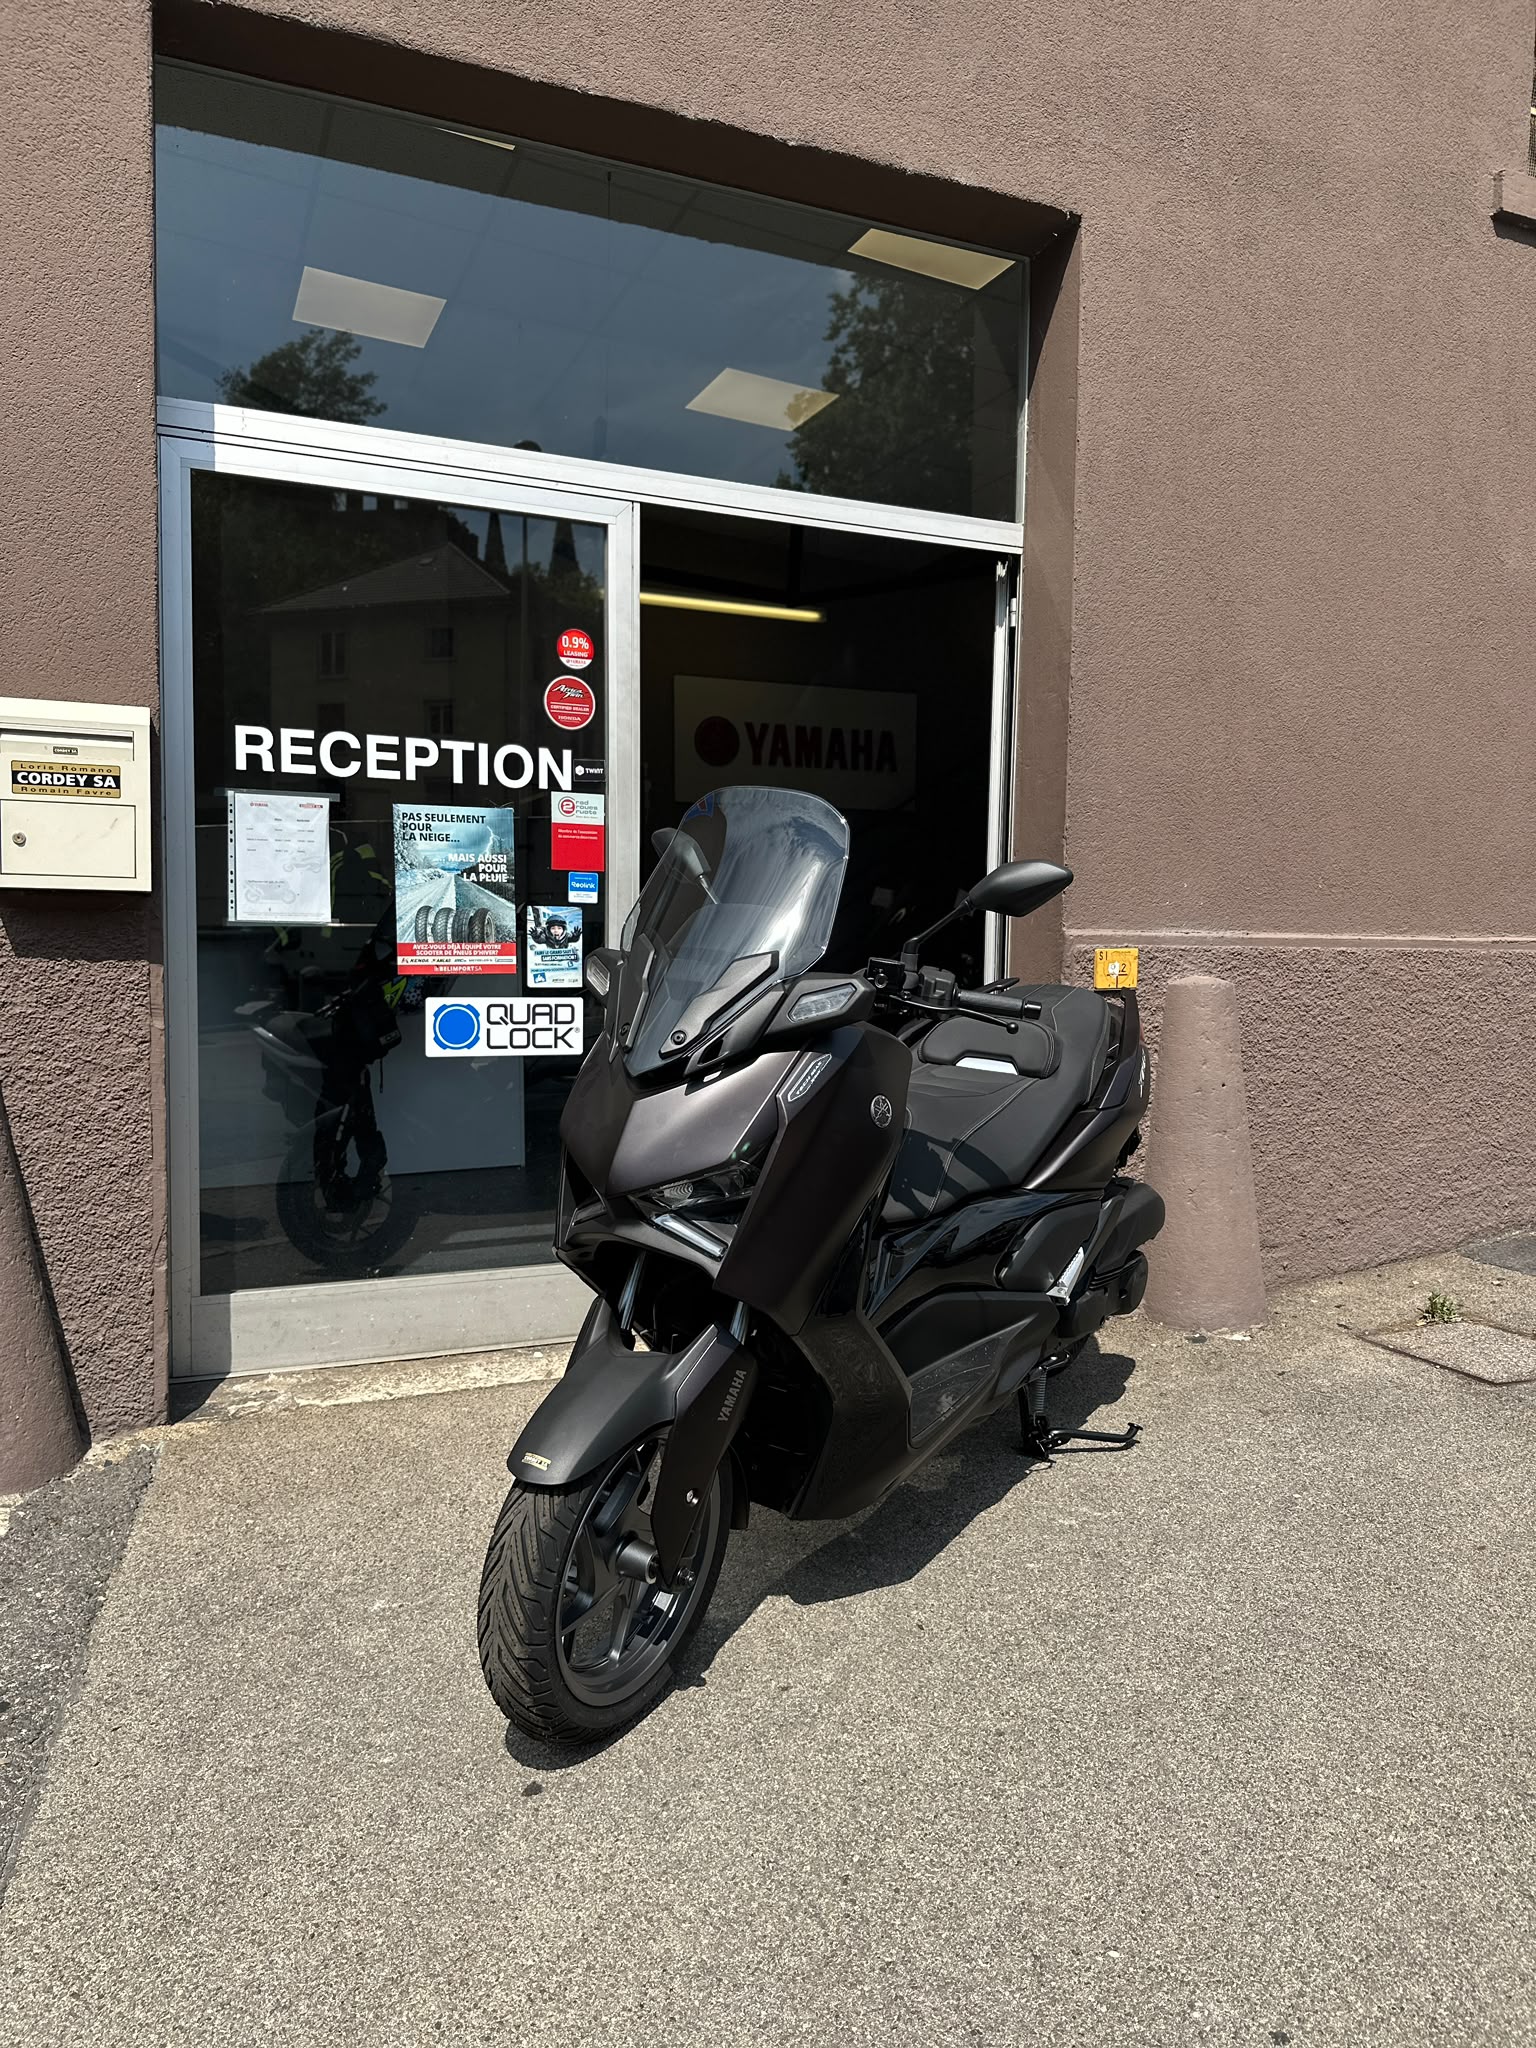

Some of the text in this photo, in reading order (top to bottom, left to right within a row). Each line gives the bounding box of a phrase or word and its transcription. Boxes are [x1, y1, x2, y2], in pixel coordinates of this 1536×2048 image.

[562, 635, 590, 650] 0.9%
[744, 722, 898, 773] YAMAHA
[235, 725, 572, 790] RECEPTION
[20, 763, 112, 774] Loris Romano
[17, 772, 116, 788] CORDEY SA
[21, 786, 69, 794] Romain
[402, 812, 486, 824] PAS SEULEMENT
[402, 822, 432, 832] POUR
[402, 832, 460, 843] LA NEIGE...
[478, 854, 507, 863] AUSSI
[478, 863, 507, 873] POUR
[463, 872, 508, 883] LA PLUIE
[571, 881, 595, 889] Reolink
[447, 943, 461, 951] DÉJÀ
[486, 1003, 575, 1026] QUAD
[717, 1369, 747, 1422] YAMAHA
